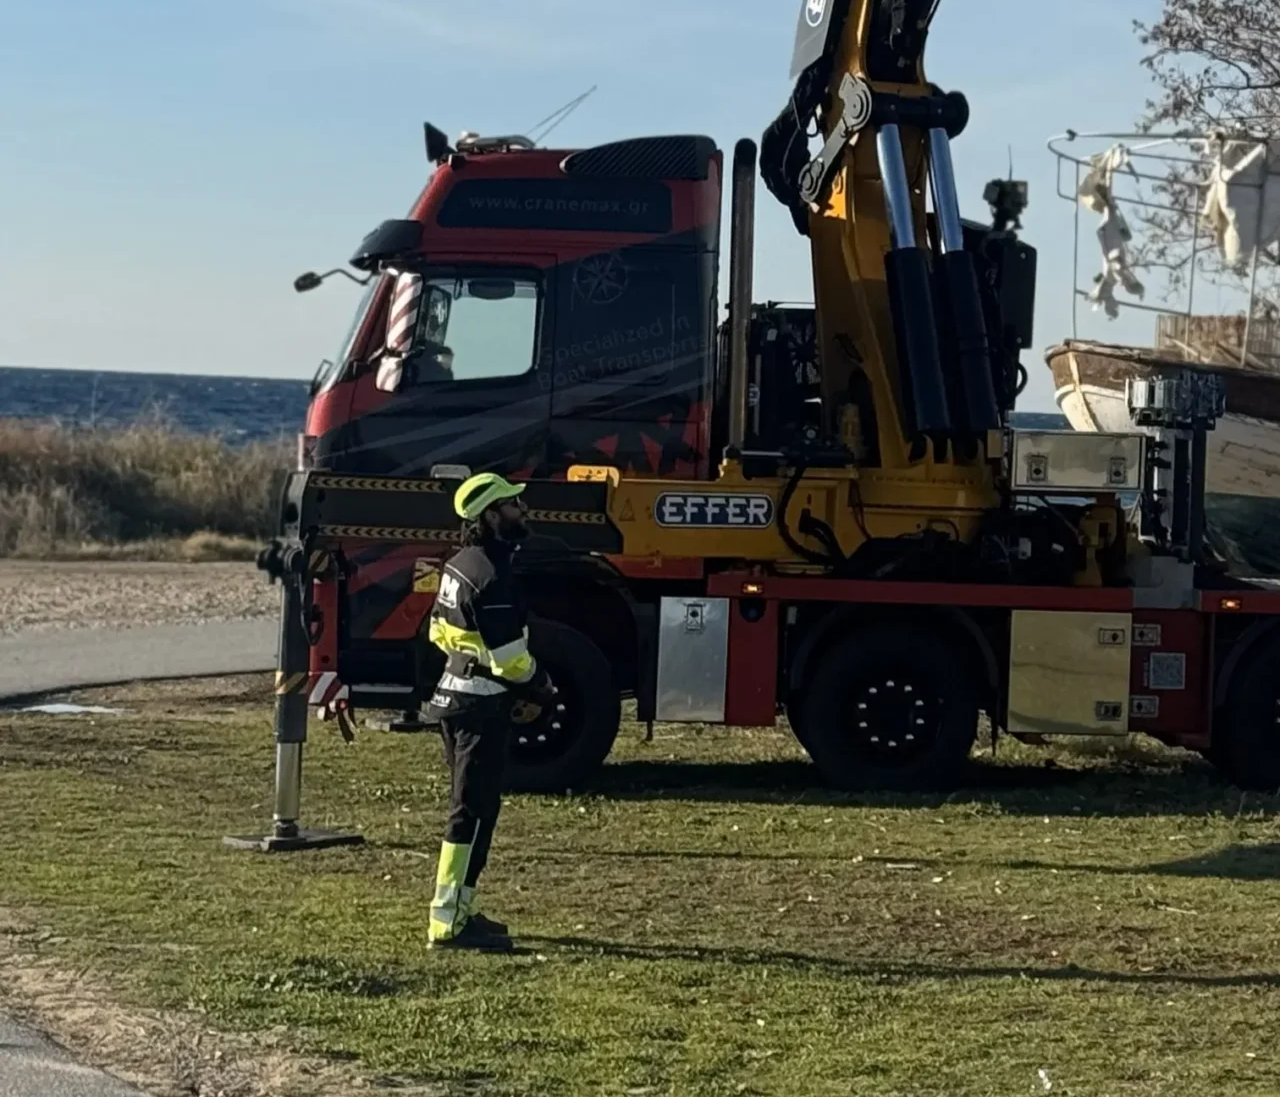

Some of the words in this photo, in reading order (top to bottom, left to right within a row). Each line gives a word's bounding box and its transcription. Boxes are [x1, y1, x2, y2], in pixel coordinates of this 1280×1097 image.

[467, 194, 649, 216] www.cranemax.gr
[541, 315, 665, 367] Specialized
[662, 496, 768, 523] EFFER
